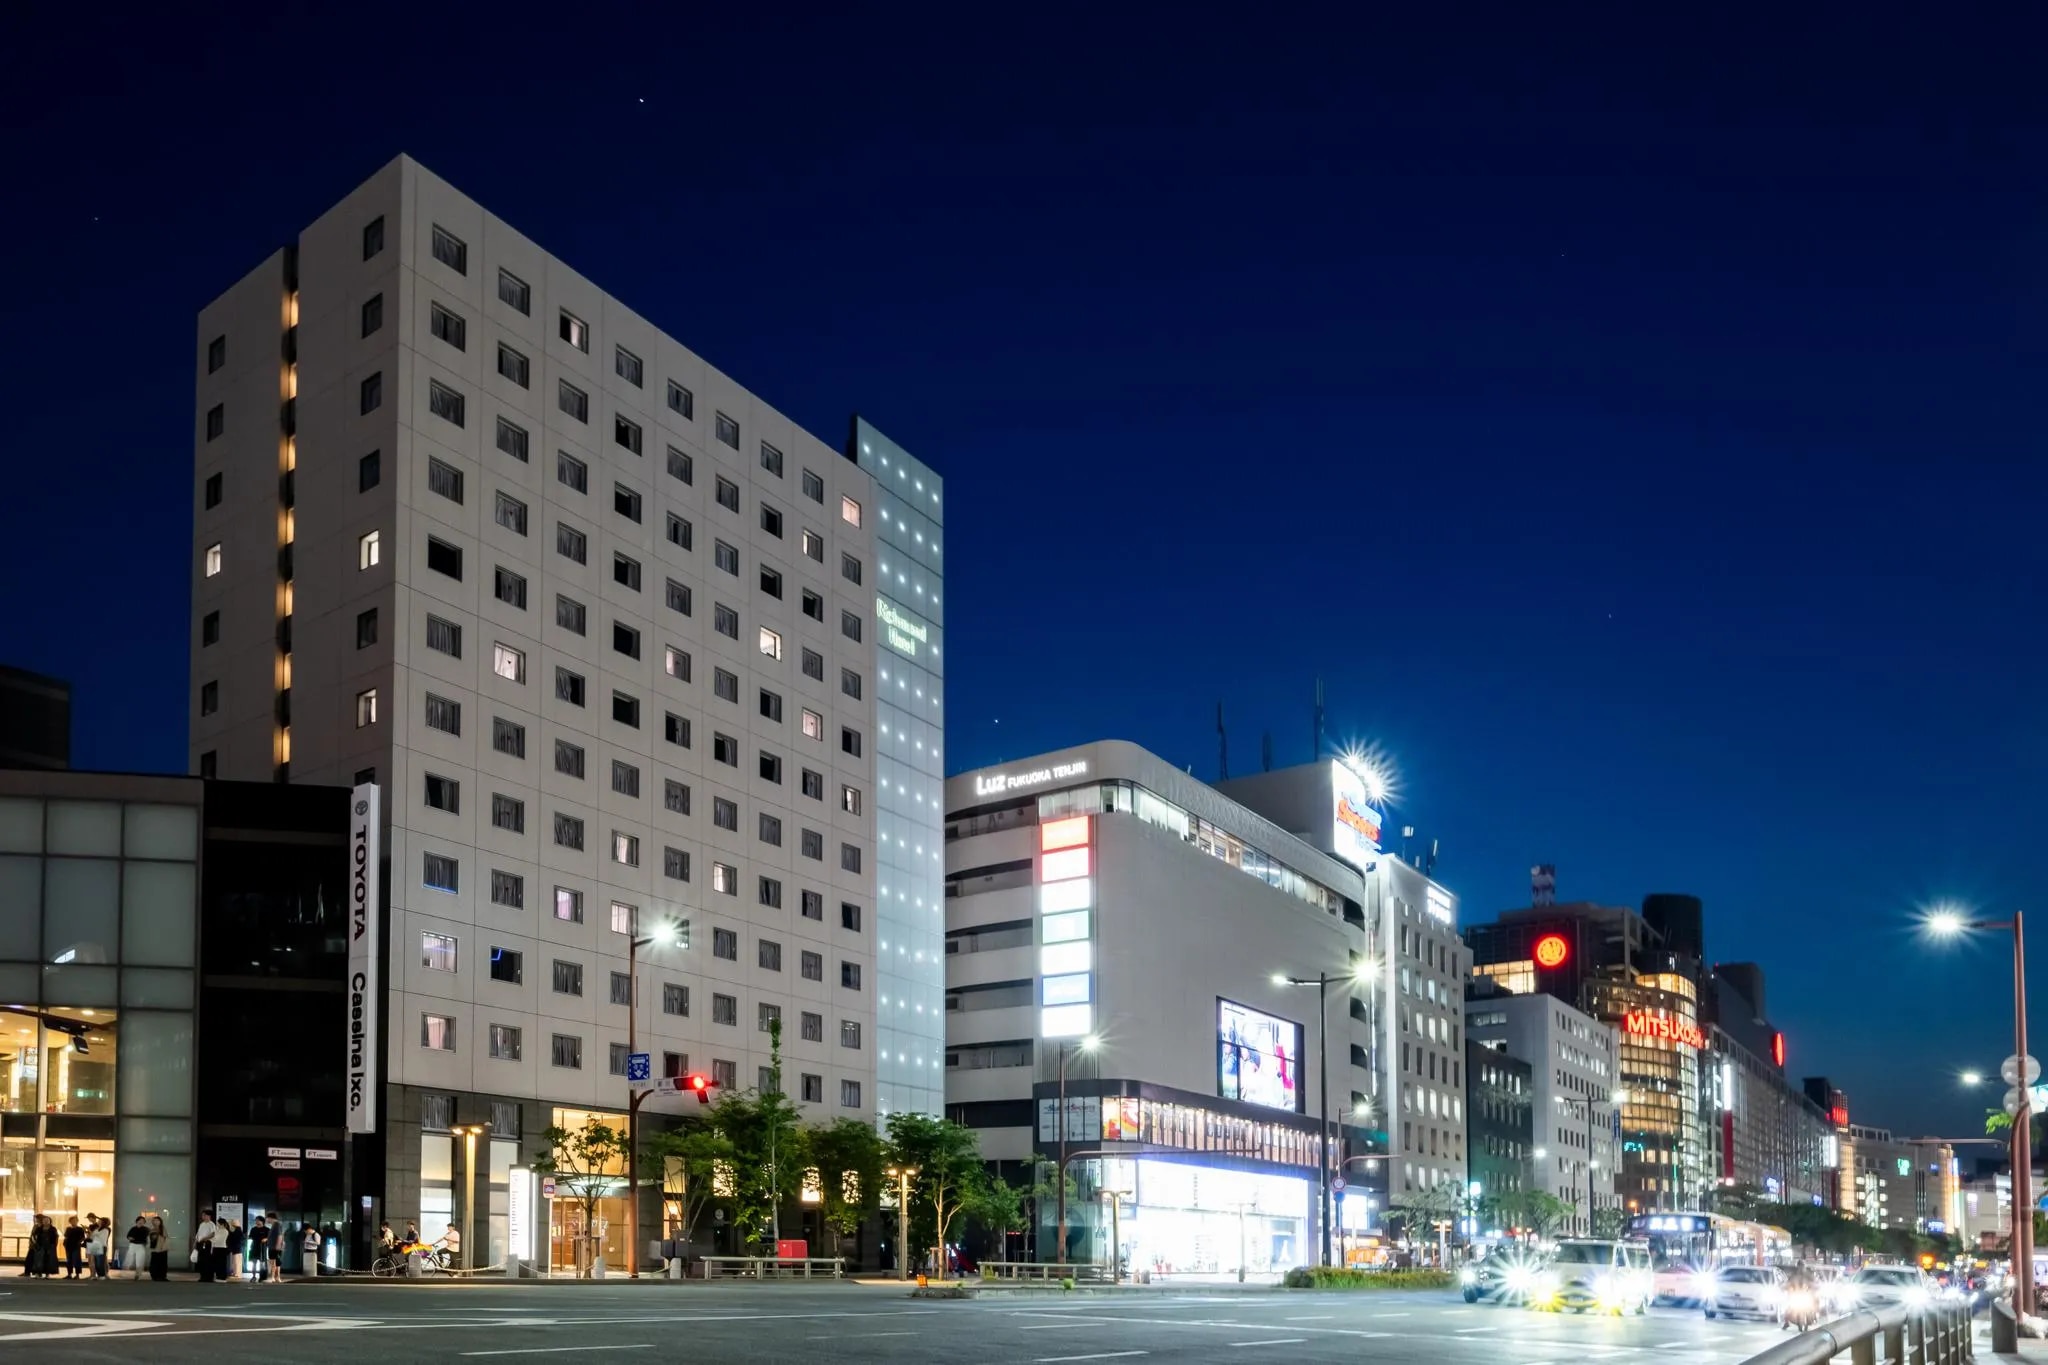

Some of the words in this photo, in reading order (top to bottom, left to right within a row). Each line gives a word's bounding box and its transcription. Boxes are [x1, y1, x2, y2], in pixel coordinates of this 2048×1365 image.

[1007, 769, 1052, 789] FUKUOKA
[1052, 761, 1087, 779] TENJIN
[354, 824, 367, 941] TOYOTA
